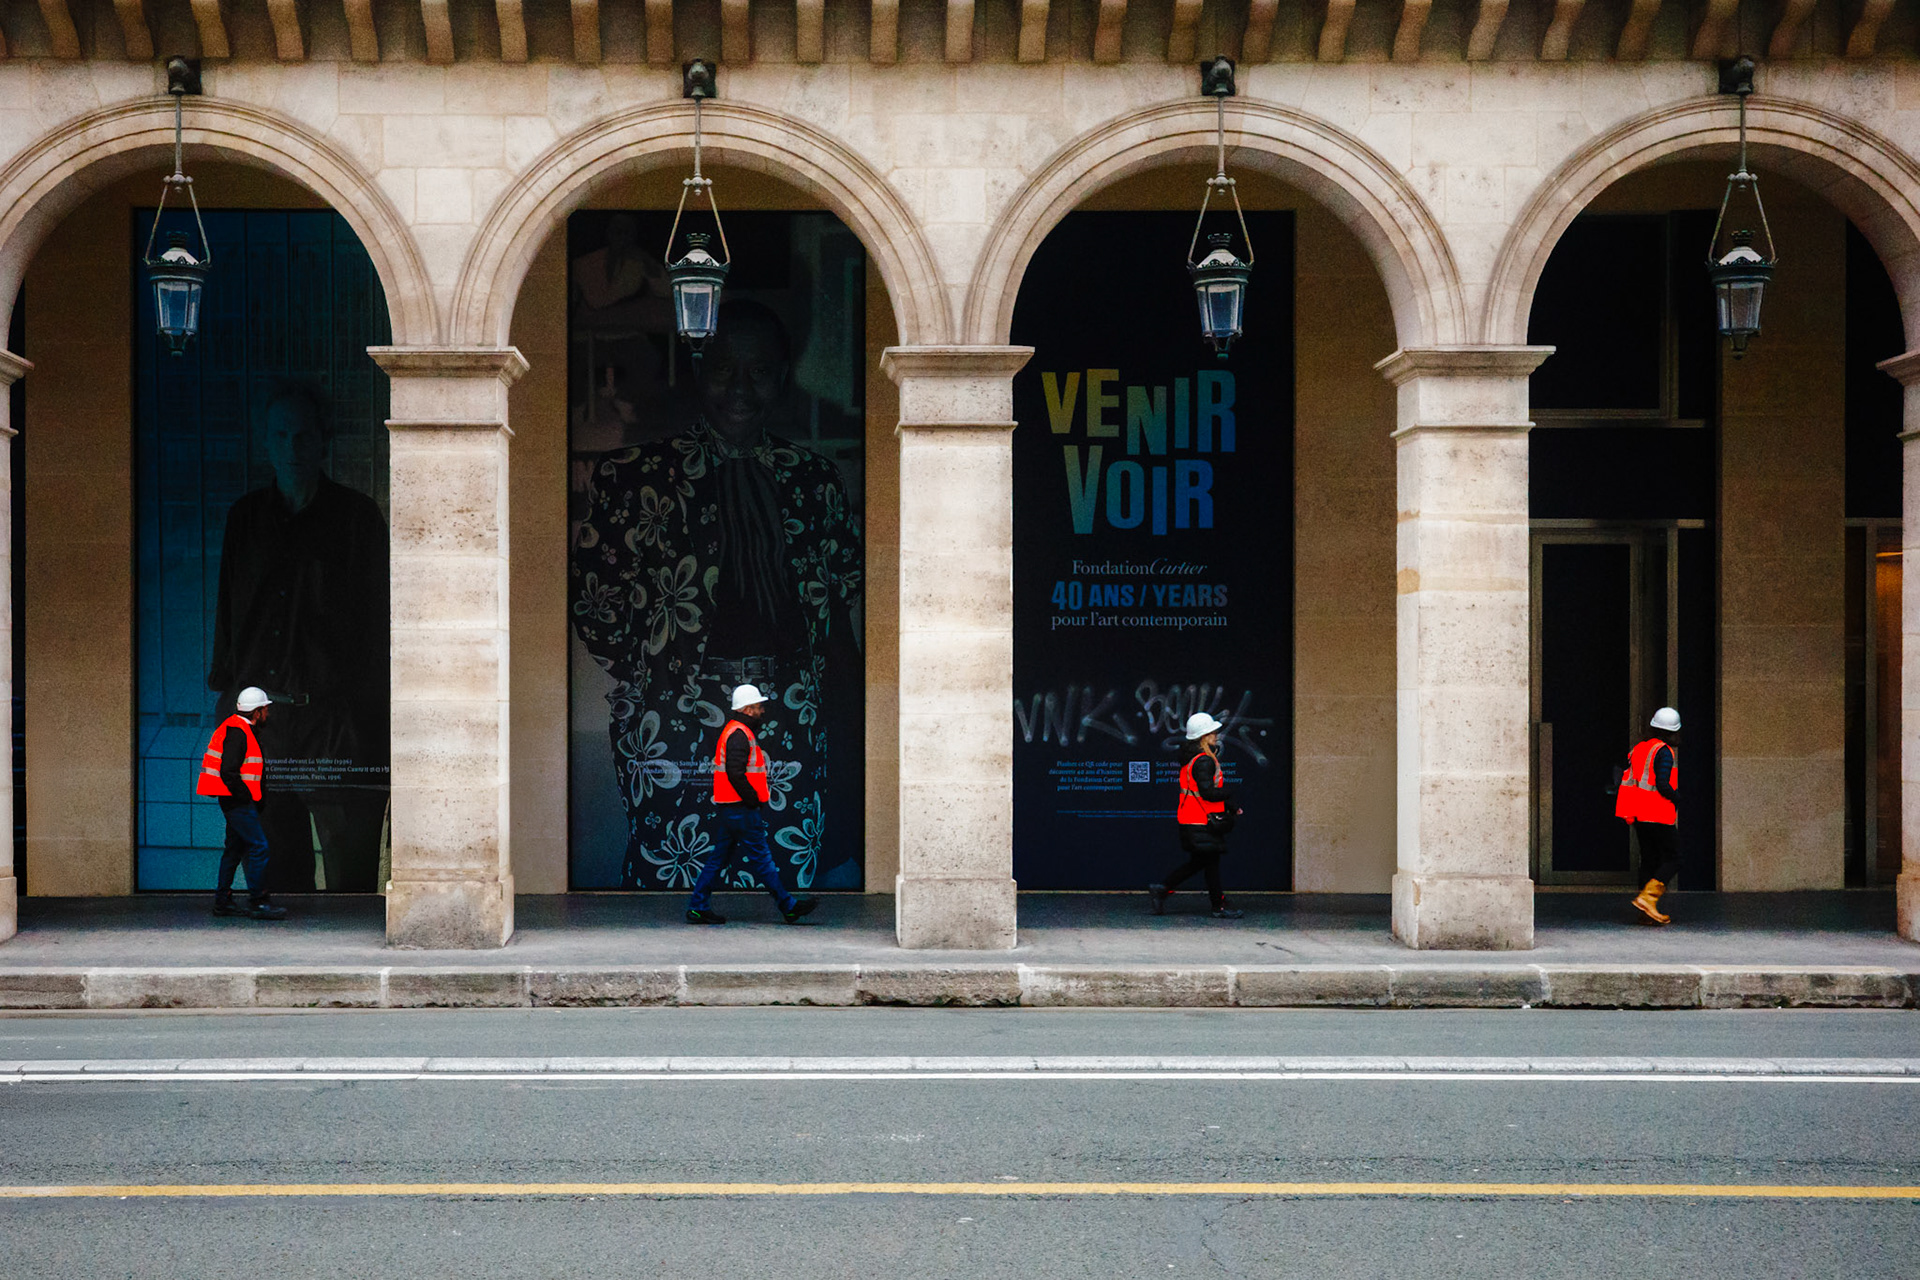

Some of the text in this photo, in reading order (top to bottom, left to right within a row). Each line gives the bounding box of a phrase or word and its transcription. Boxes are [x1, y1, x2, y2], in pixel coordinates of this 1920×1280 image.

[1041, 368, 1236, 455] VENIR
[1063, 445, 1214, 535] VOIR
[1051, 581, 1082, 610] 40
[1088, 584, 1134, 607] ANS
[1152, 584, 1228, 607] YEARS
[1051, 612, 1228, 630] pour l'art contemporain
